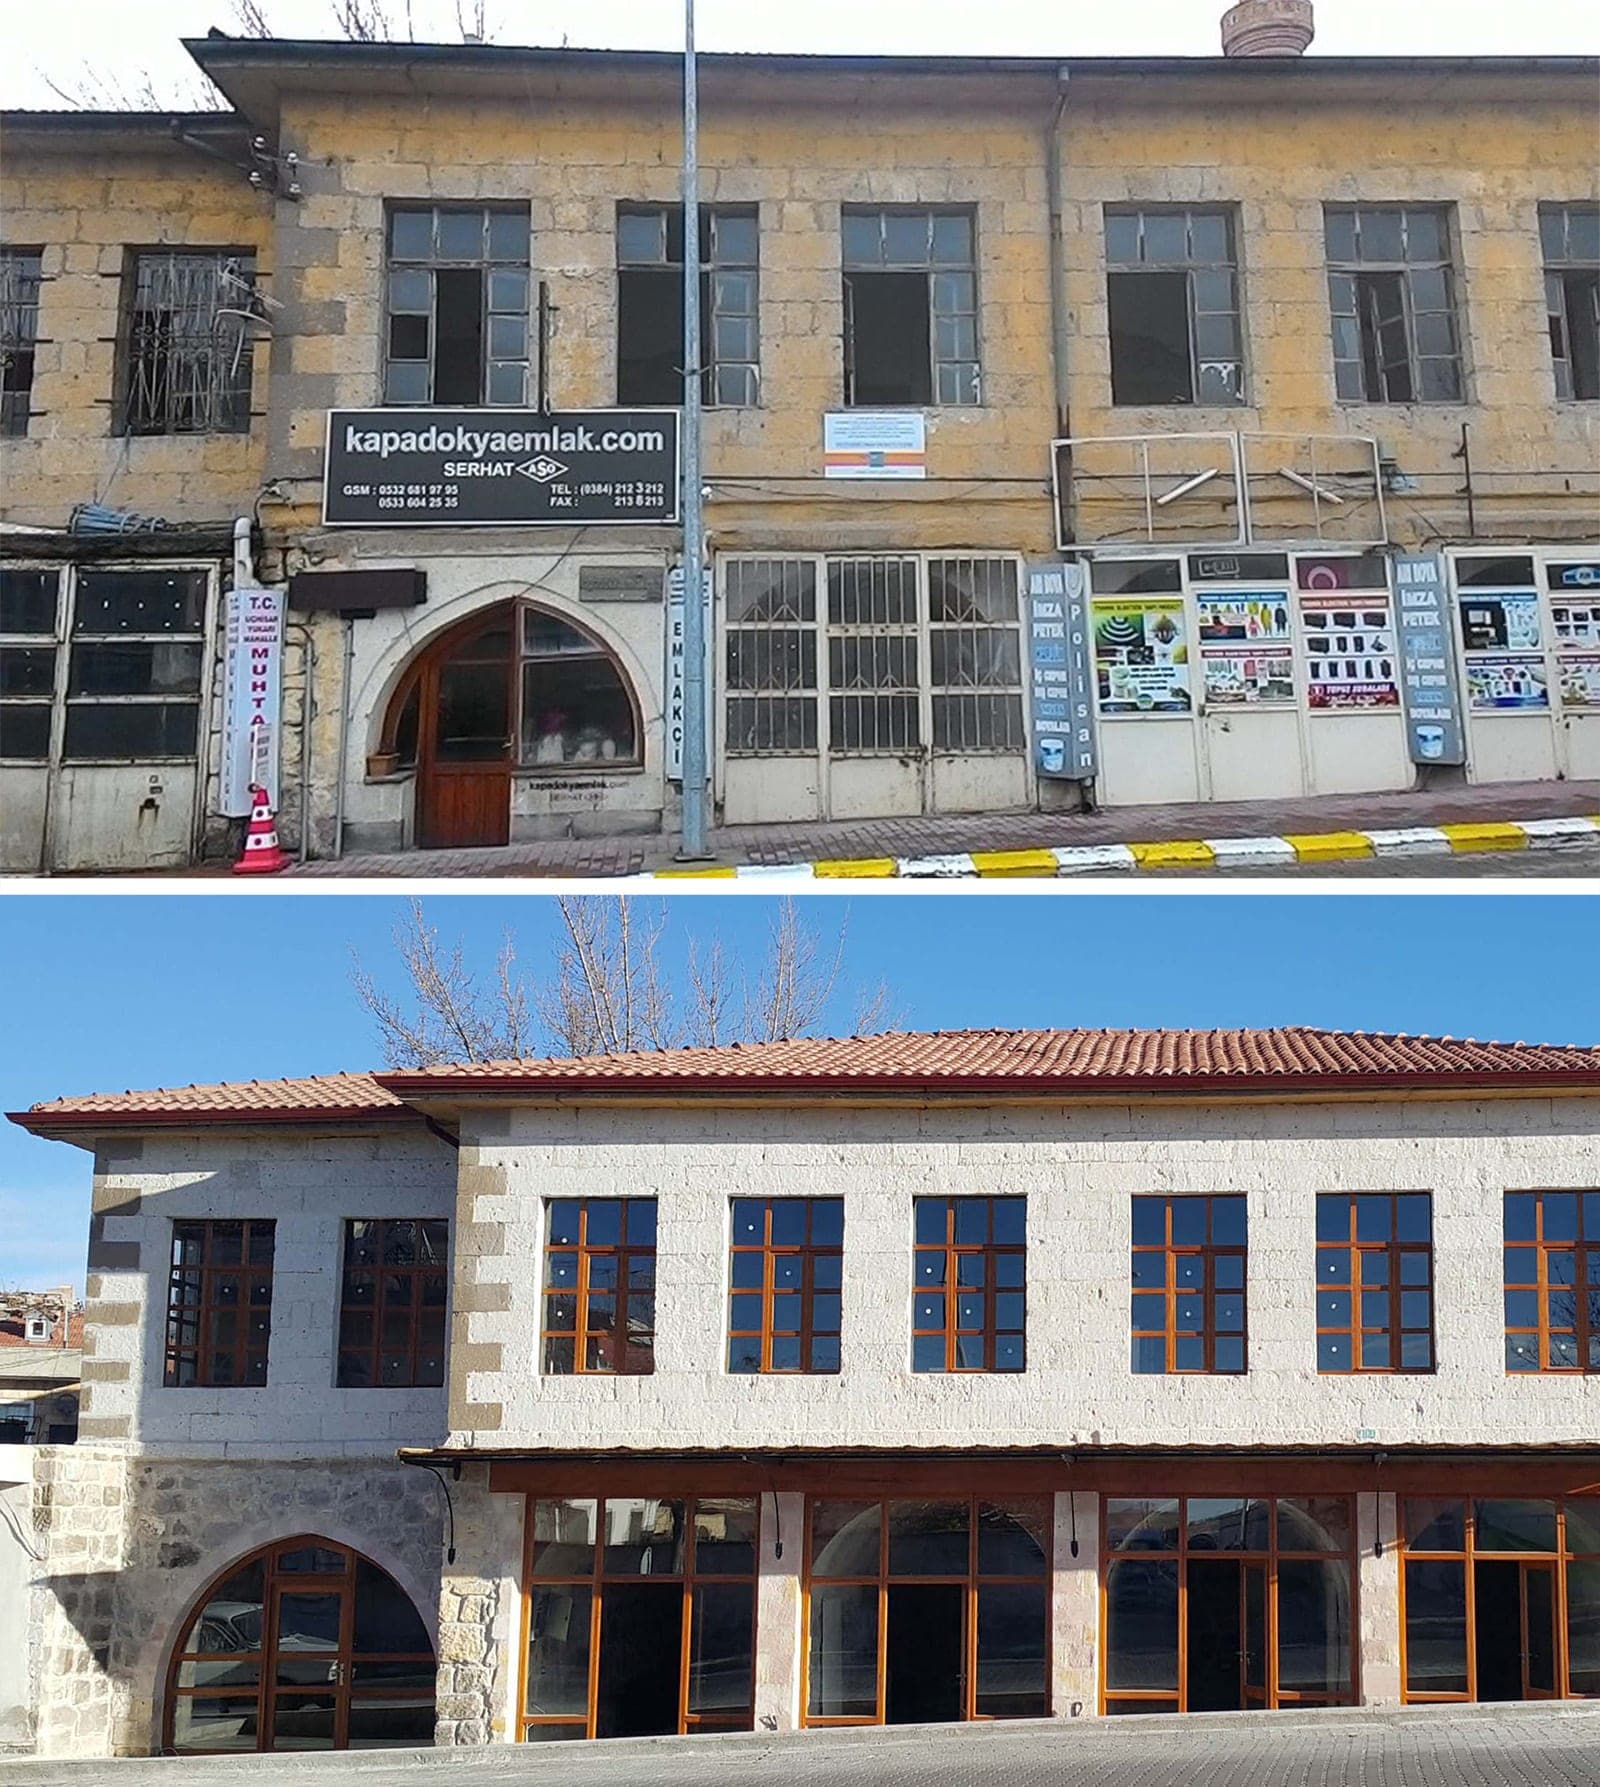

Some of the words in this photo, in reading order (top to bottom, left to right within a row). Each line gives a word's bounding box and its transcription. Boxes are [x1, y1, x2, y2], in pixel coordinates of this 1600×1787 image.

[345, 426, 664, 457] kapadokyaemlak.com
[443, 462, 515, 477] SERHAT
[528, 461, 556, 477] ASO
[343, 484, 370, 496] GSM
[379, 484, 405, 496] 0532
[550, 484, 571, 495] TEL
[615, 483, 634, 494] 212
[635, 481, 644, 494] 3
[645, 483, 664, 494] 212
[550, 496, 572, 507] FAX
[614, 496, 634, 507] 213
[645, 496, 664, 507] 213
[249, 596, 277, 610] T.C.
[1070, 604, 1092, 767] Polisan
